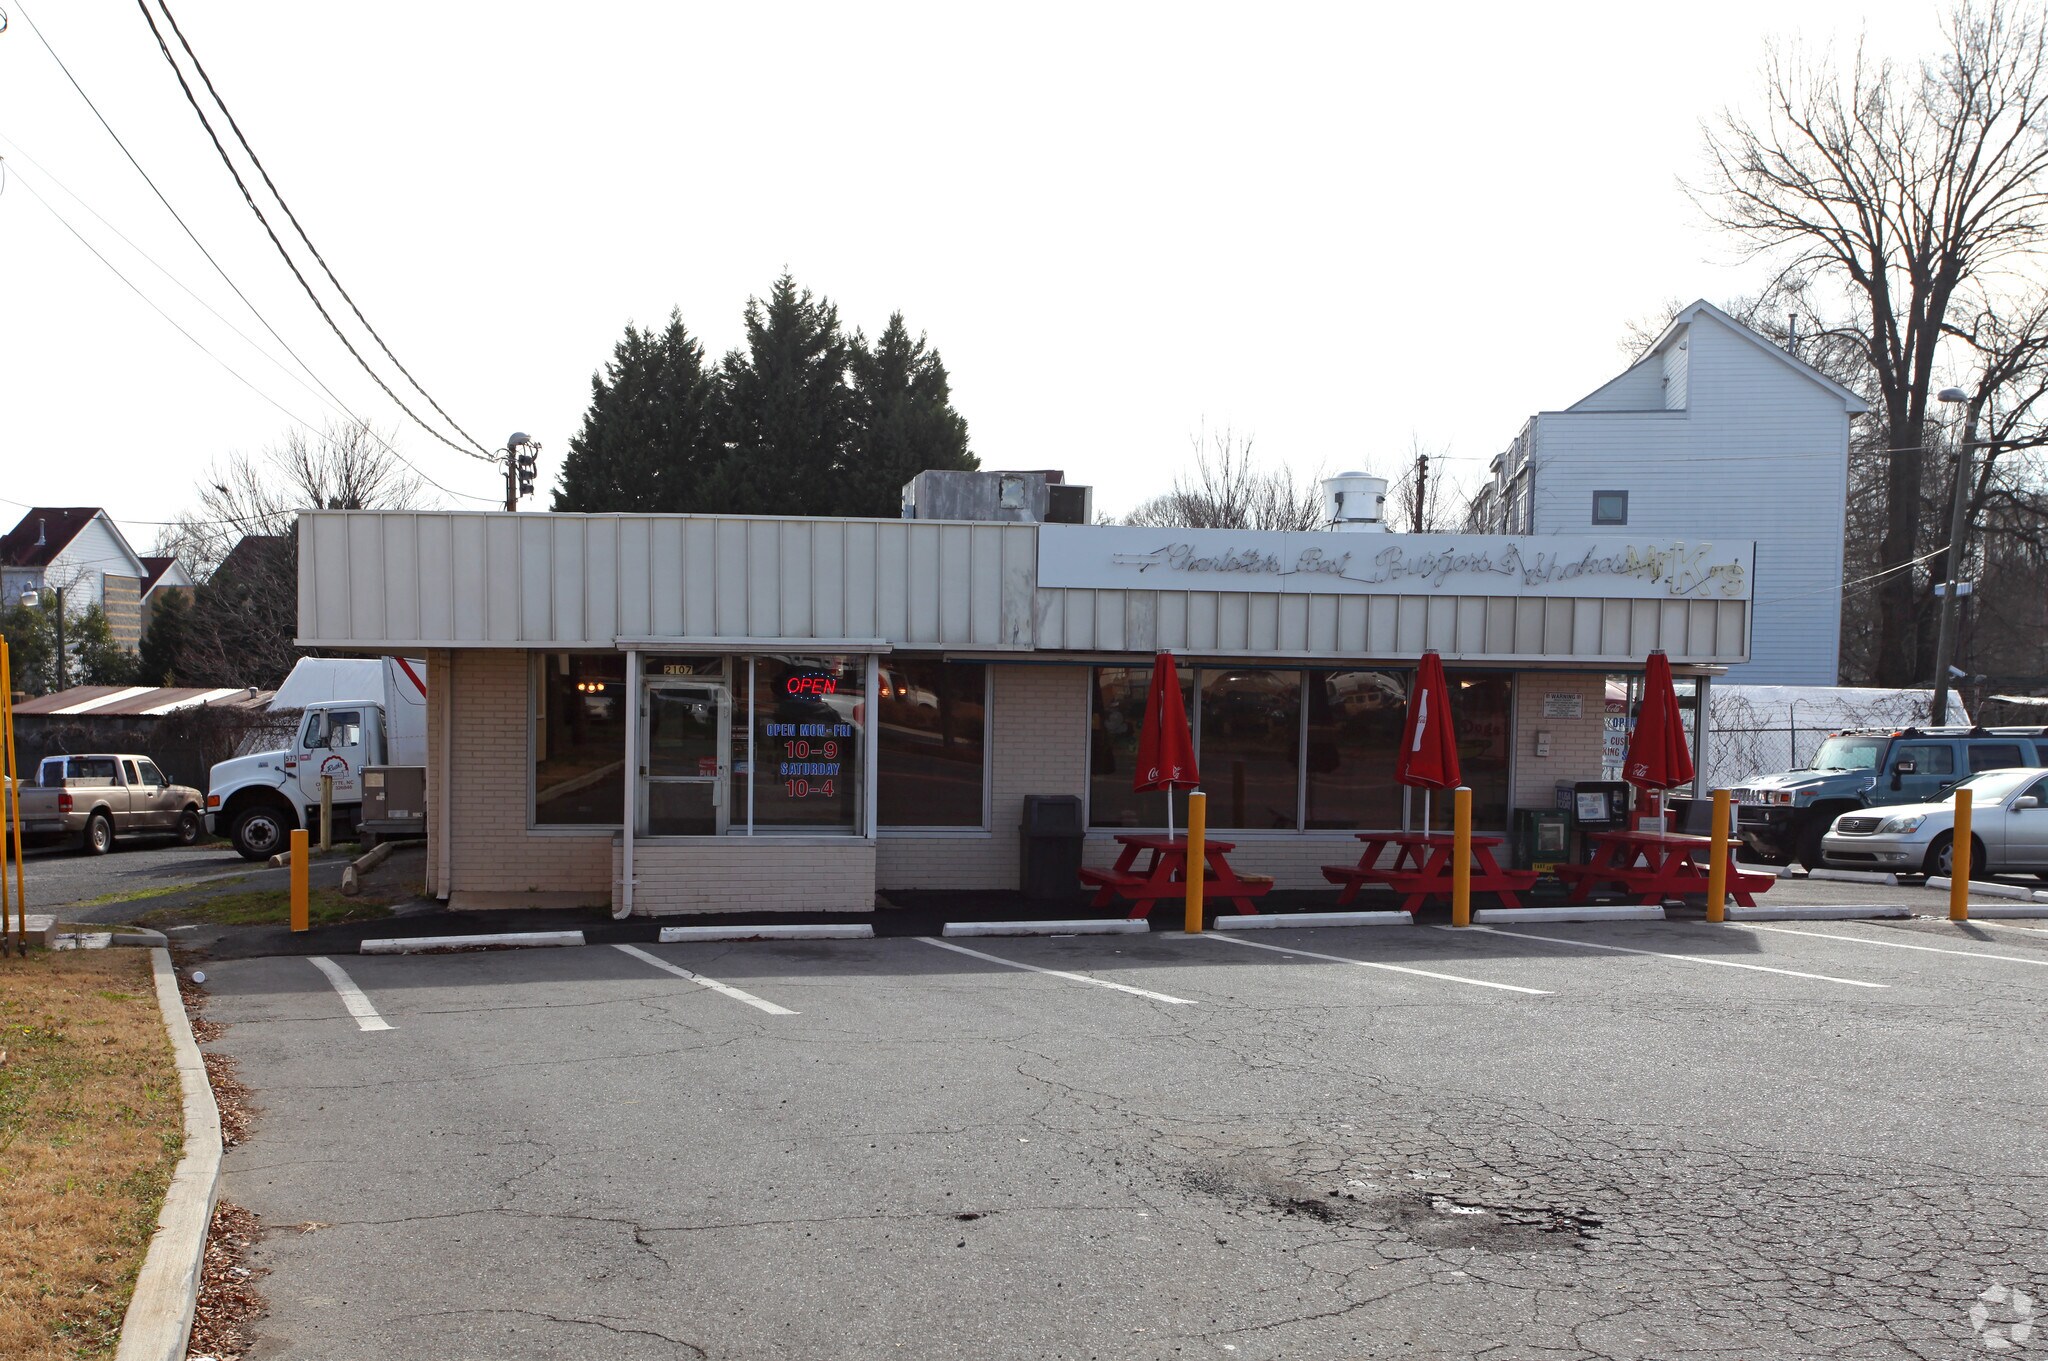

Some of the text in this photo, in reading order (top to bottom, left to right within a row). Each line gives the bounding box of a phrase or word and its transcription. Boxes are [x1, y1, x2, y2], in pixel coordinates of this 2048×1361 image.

[1296, 547, 1351, 575] Best
[1375, 546, 1490, 588] Burgers
[1525, 545, 1624, 586] Shakes
[665, 665, 692, 674] 2107
[786, 677, 837, 695] OPEN
[766, 723, 852, 737] OPEN MON-FRI
[784, 740, 838, 759] 10-9
[780, 762, 841, 776] SATURDAY
[785, 779, 834, 798] 10-4
